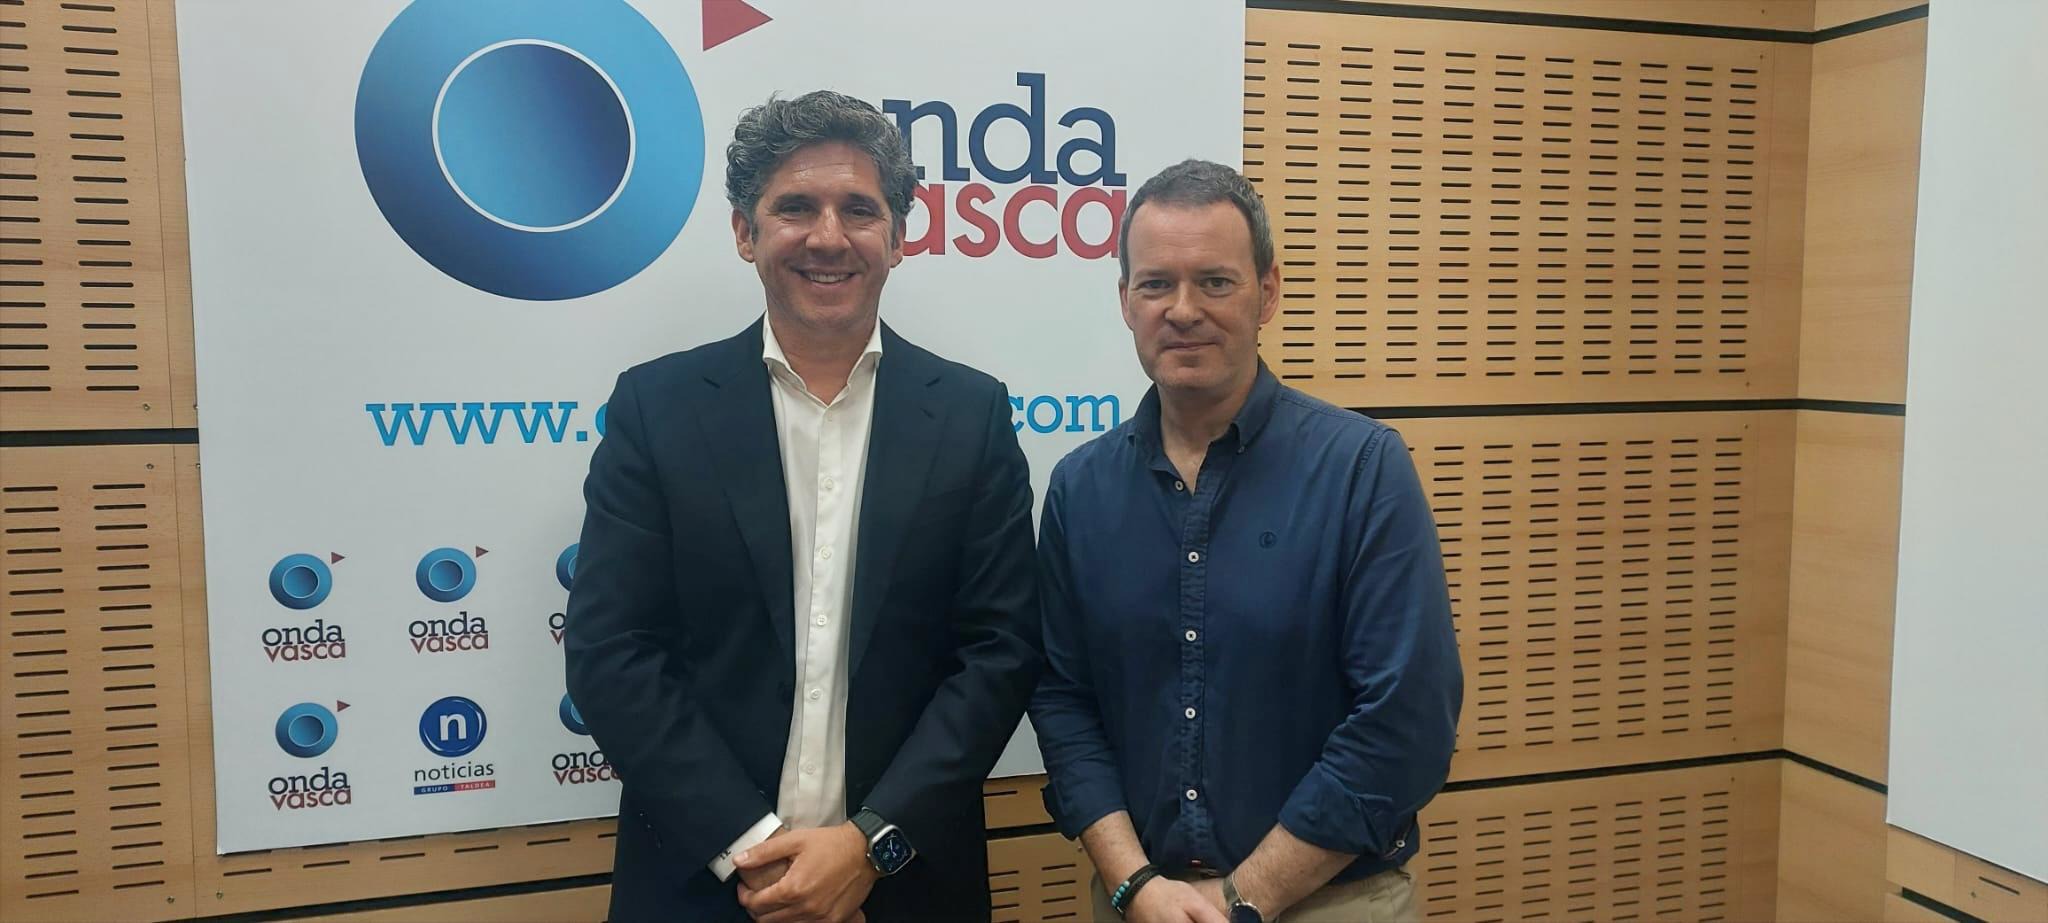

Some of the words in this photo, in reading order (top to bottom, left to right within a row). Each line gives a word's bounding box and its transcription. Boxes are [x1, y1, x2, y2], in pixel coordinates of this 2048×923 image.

[882, 71, 1127, 186] nda
[902, 183, 1127, 260] asca
[262, 619, 344, 647] onda
[408, 612, 488, 639] onda
[264, 641, 346, 663] vasca
[409, 633, 489, 654] vasca
[439, 712, 467, 741] n
[414, 761, 494, 782] noticias
[552, 750, 606, 770] ond
[268, 766, 351, 795] onda
[421, 785, 448, 793] GRUPO
[460, 782, 490, 790] TALDEA
[269, 788, 352, 811] vasca
